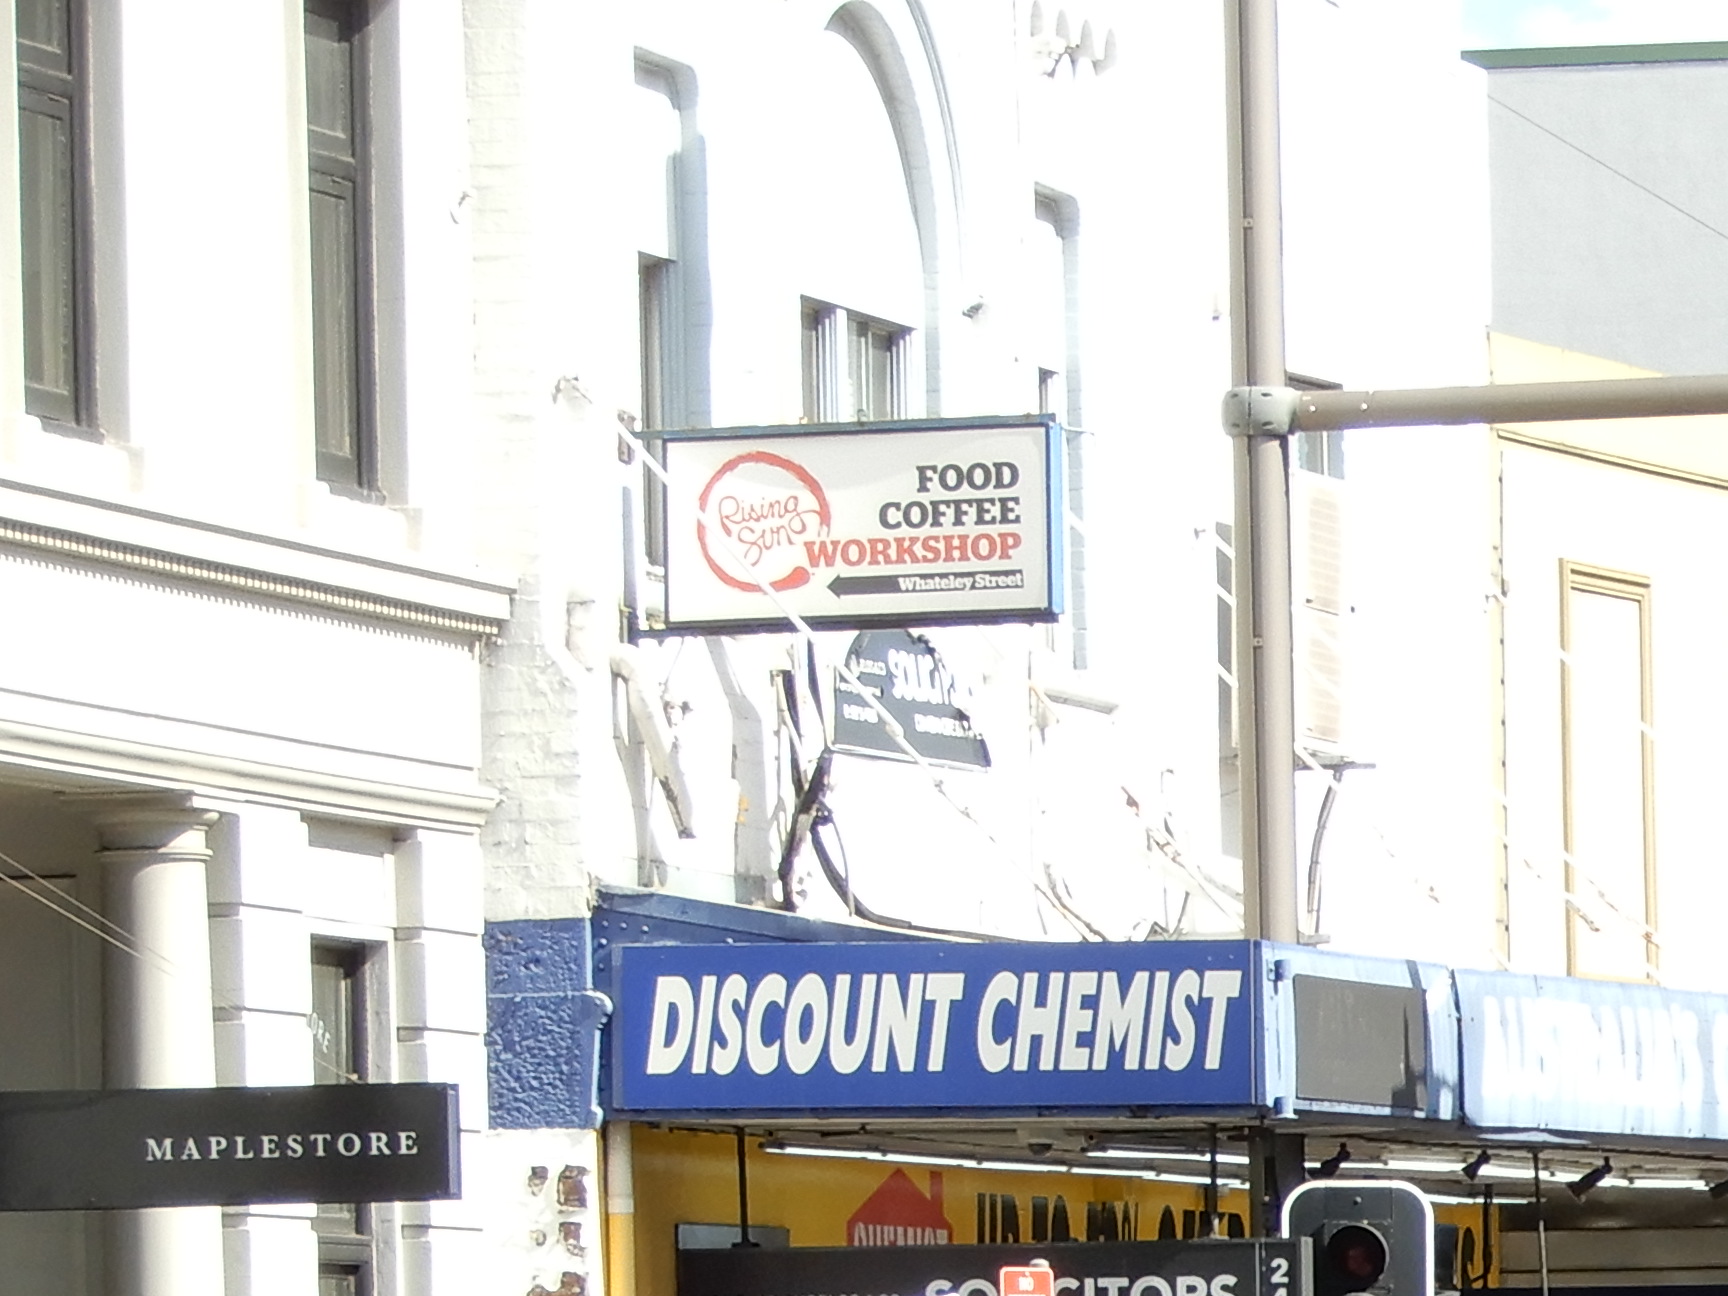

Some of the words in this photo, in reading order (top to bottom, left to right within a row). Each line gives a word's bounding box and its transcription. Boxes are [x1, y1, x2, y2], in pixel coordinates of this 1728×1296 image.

[916, 462, 1019, 493] FOOD
[718, 494, 820, 536] Rising
[878, 496, 1021, 529] COFFEE
[737, 525, 796, 566] Sun
[804, 532, 1022, 568] WORKSHOP
[898, 573, 973, 591] Whateley
[975, 572, 1022, 589] Street
[642, 972, 966, 1075] DISCOUNT
[977, 969, 1242, 1072] CHEMIST
[145, 1131, 418, 1161] MAPLESTORE
[1018, 1277, 1034, 1291] NO
